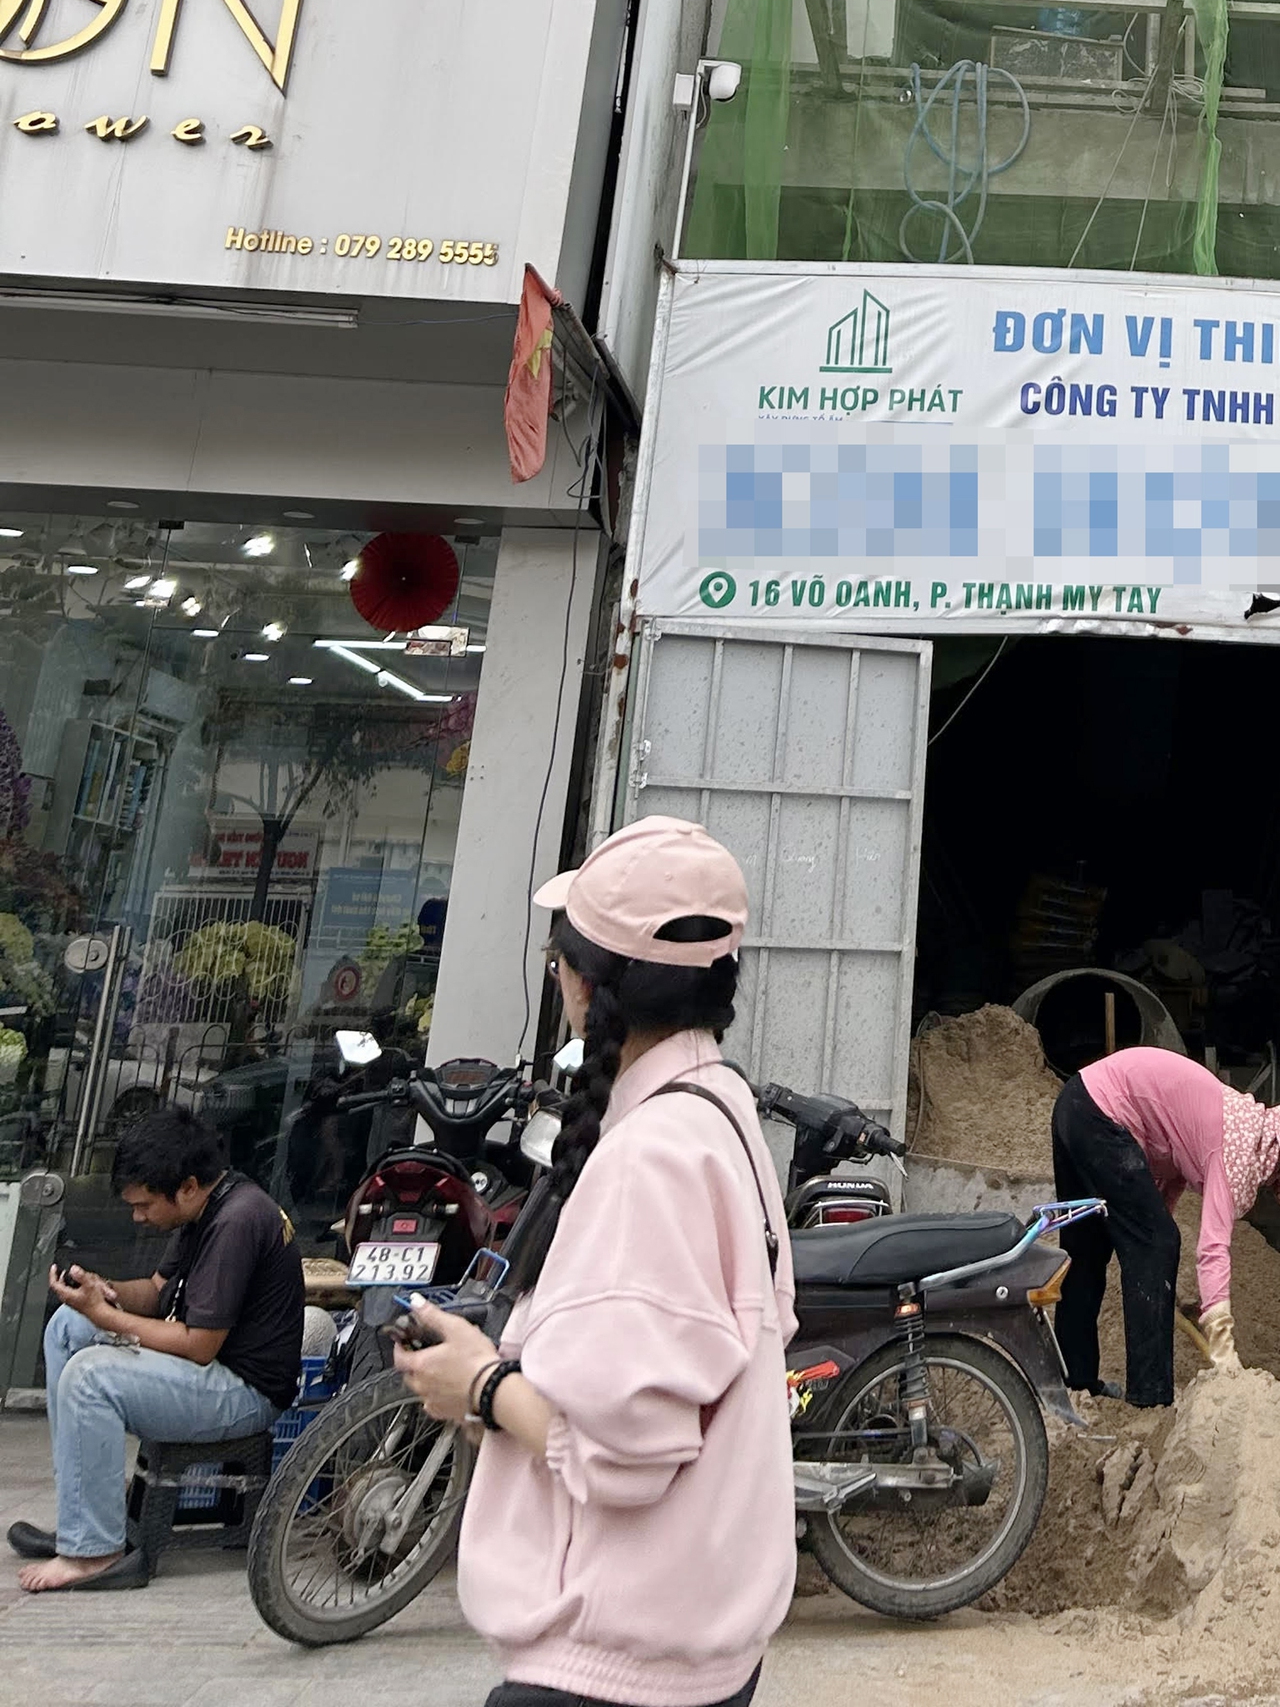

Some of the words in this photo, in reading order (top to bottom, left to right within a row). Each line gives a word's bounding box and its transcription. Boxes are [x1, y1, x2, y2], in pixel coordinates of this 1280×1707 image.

[224, 226, 313, 255] Hotline
[333, 233, 381, 258] 079
[386, 237, 433, 262] 289
[438, 240, 500, 266] 5555
[992, 308, 1105, 355] ĐƠN
[1125, 315, 1175, 369] VỊ
[757, 385, 810, 411] KIM
[819, 384, 880, 418] HỢP
[888, 383, 964, 414] PHÁT
[1019, 375, 1118, 418] CÔNG
[1129, 385, 1171, 419] TY
[1181, 388, 1274, 426] TNHH
[748, 579, 780, 607] 16
[790, 574, 826, 607] VÕ
[835, 579, 920, 612] OANH,
[930, 581, 952, 609] P.
[961, 582, 1053, 616] THẠNH
[827, 1182, 874, 1190] HONDA
[366, 1246, 426, 1263] 48-C1
